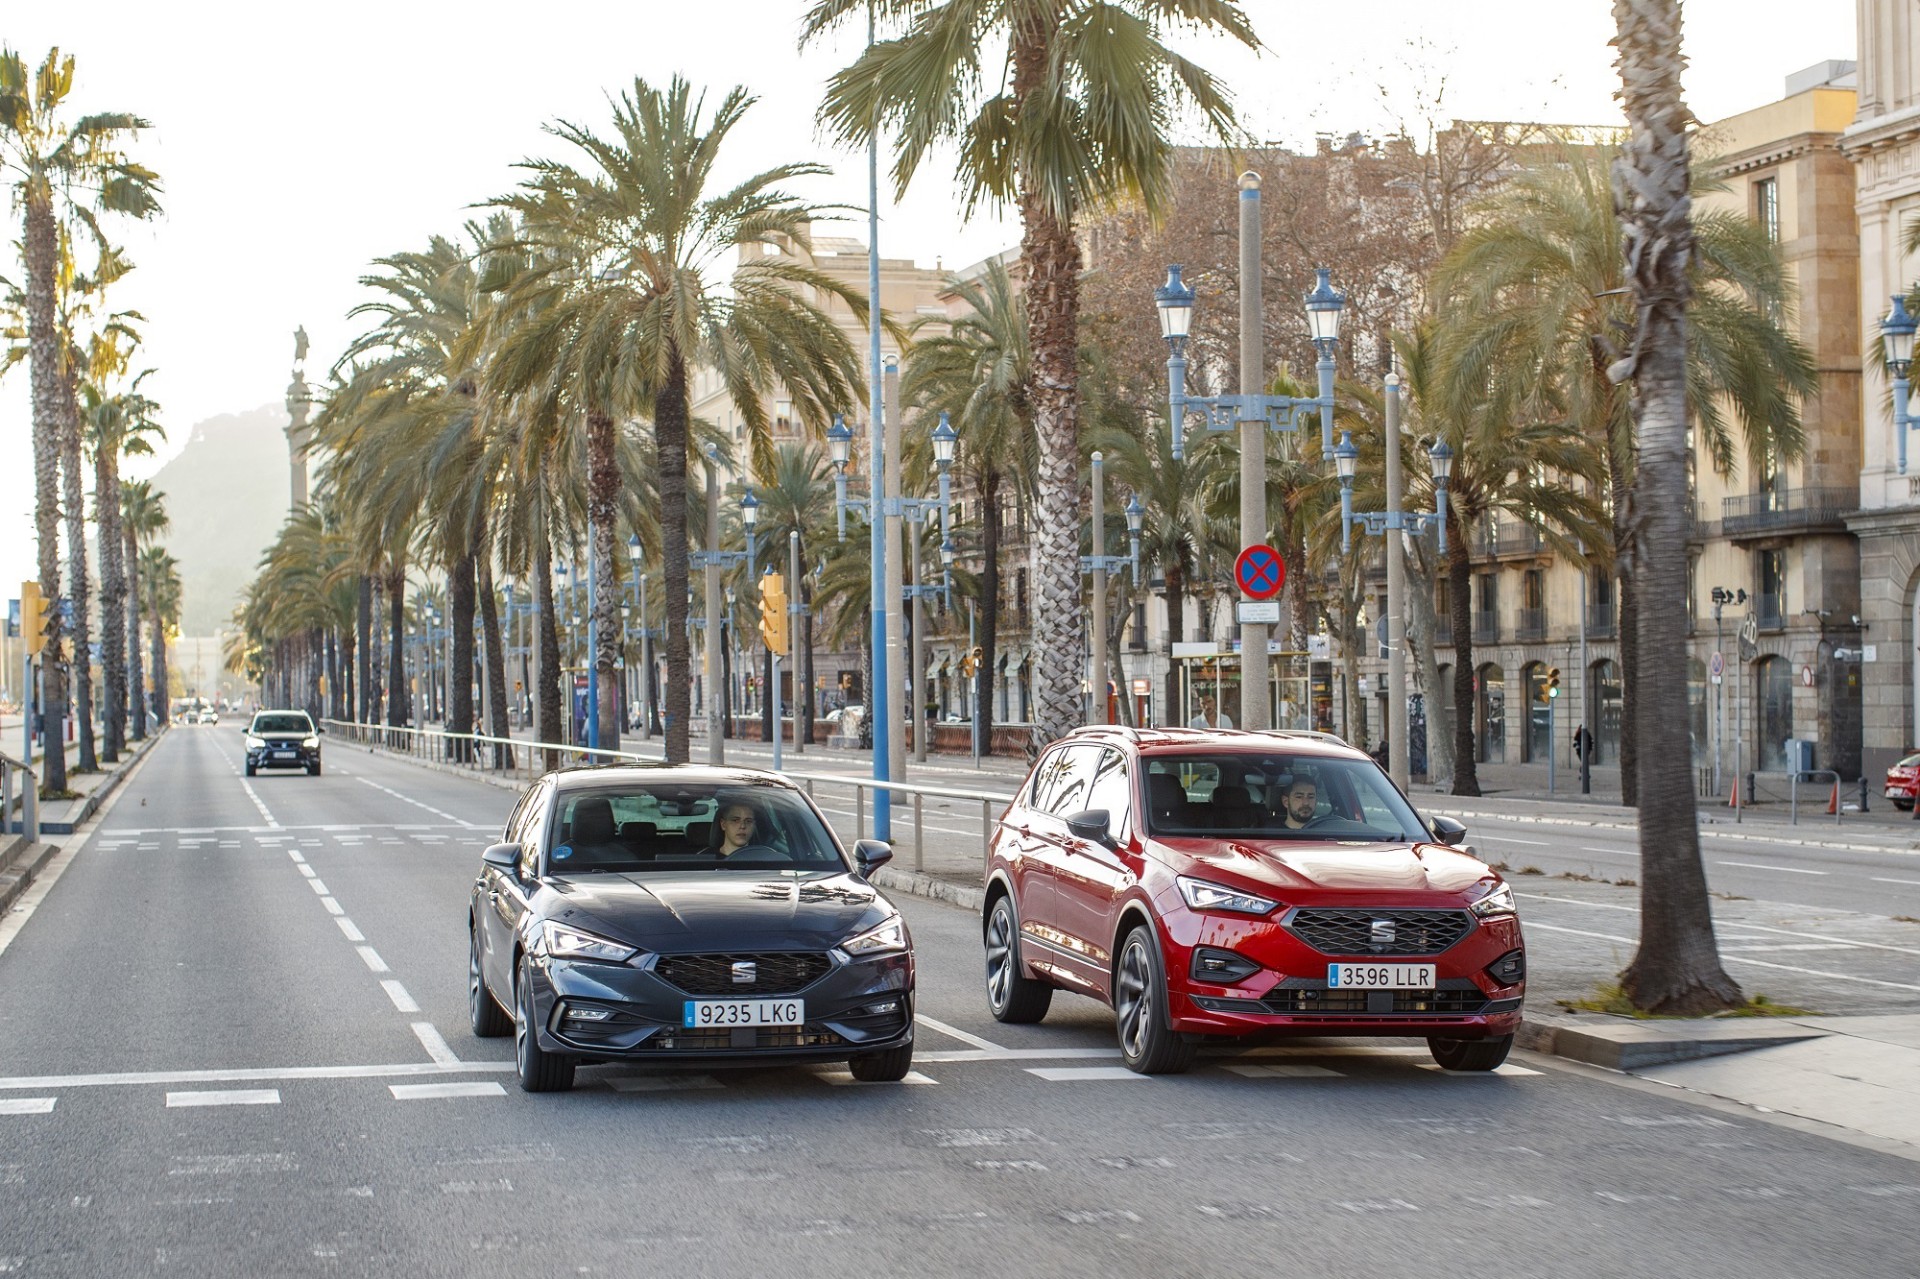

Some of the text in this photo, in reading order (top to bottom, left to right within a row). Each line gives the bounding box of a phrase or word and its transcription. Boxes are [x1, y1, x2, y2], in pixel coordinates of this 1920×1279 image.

[1343, 967, 1429, 986] 3596 LLR
[701, 1003, 797, 1024] 9235 LKG
